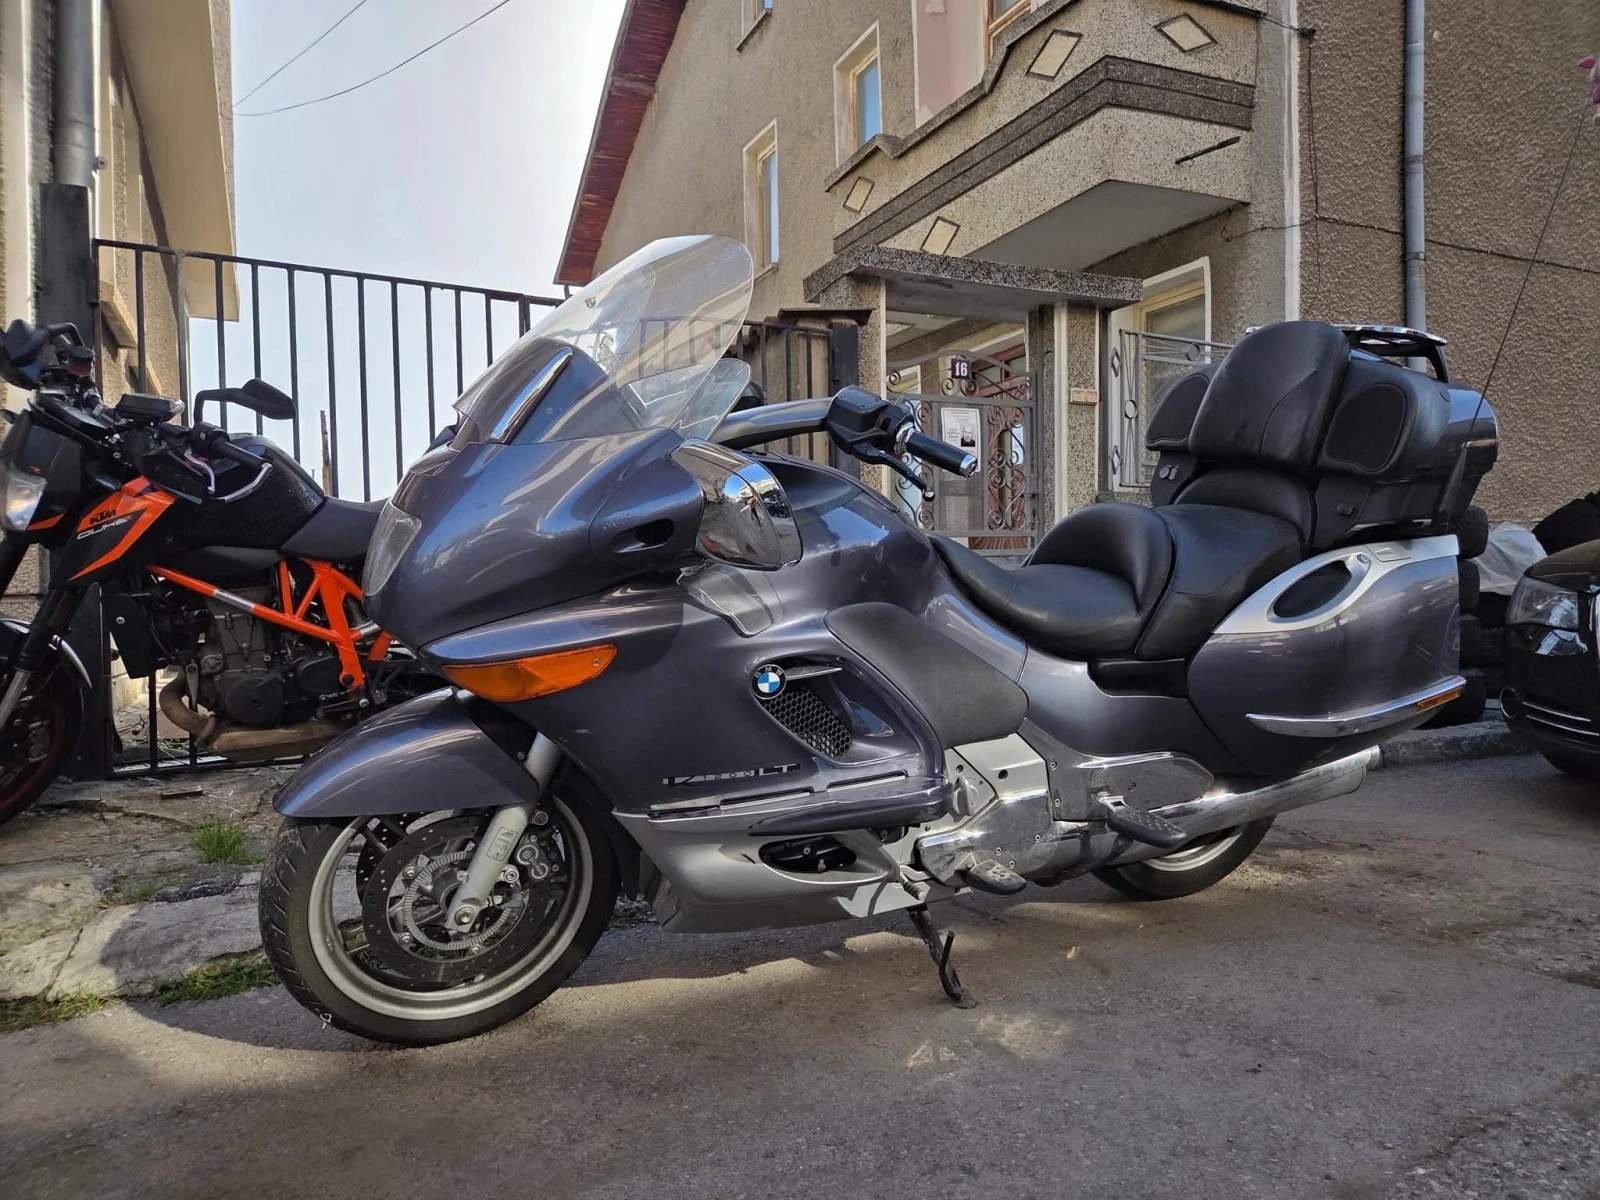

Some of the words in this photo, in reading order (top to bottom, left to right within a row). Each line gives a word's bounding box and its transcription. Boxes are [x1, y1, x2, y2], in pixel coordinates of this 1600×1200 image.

[955, 362, 968, 377] 16
[90, 509, 117, 525] KTM
[77, 518, 128, 540] DUKE
[754, 666, 783, 679] BMW
